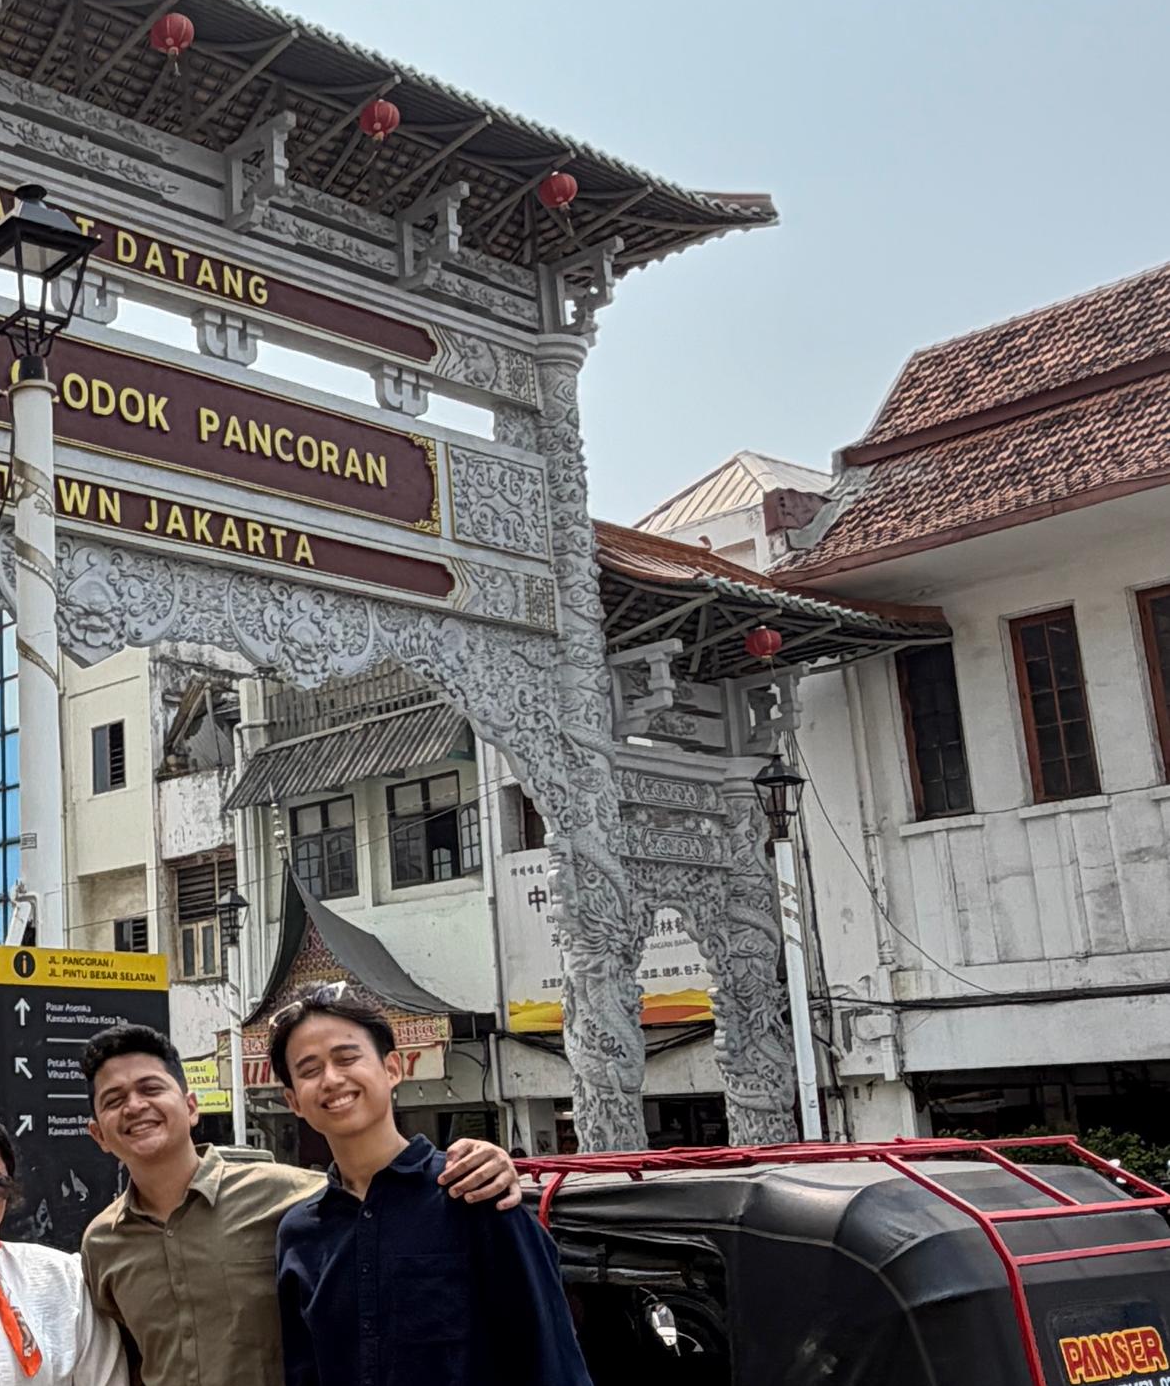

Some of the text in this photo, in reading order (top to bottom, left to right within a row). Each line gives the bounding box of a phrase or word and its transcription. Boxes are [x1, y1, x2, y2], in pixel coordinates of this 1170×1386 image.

[117, 230, 270, 306] DATANG
[11, 359, 171, 432] ODOK
[198, 407, 389, 489] PANCORAN
[144, 499, 316, 566] JAKARTA
[48, 956, 60, 965] JL.
[62, 956, 109, 967] PANCORAN
[48, 968, 156, 983] JL. PINTU BESAR SELATAN
[1059, 1326, 1169, 1385] PANSER
